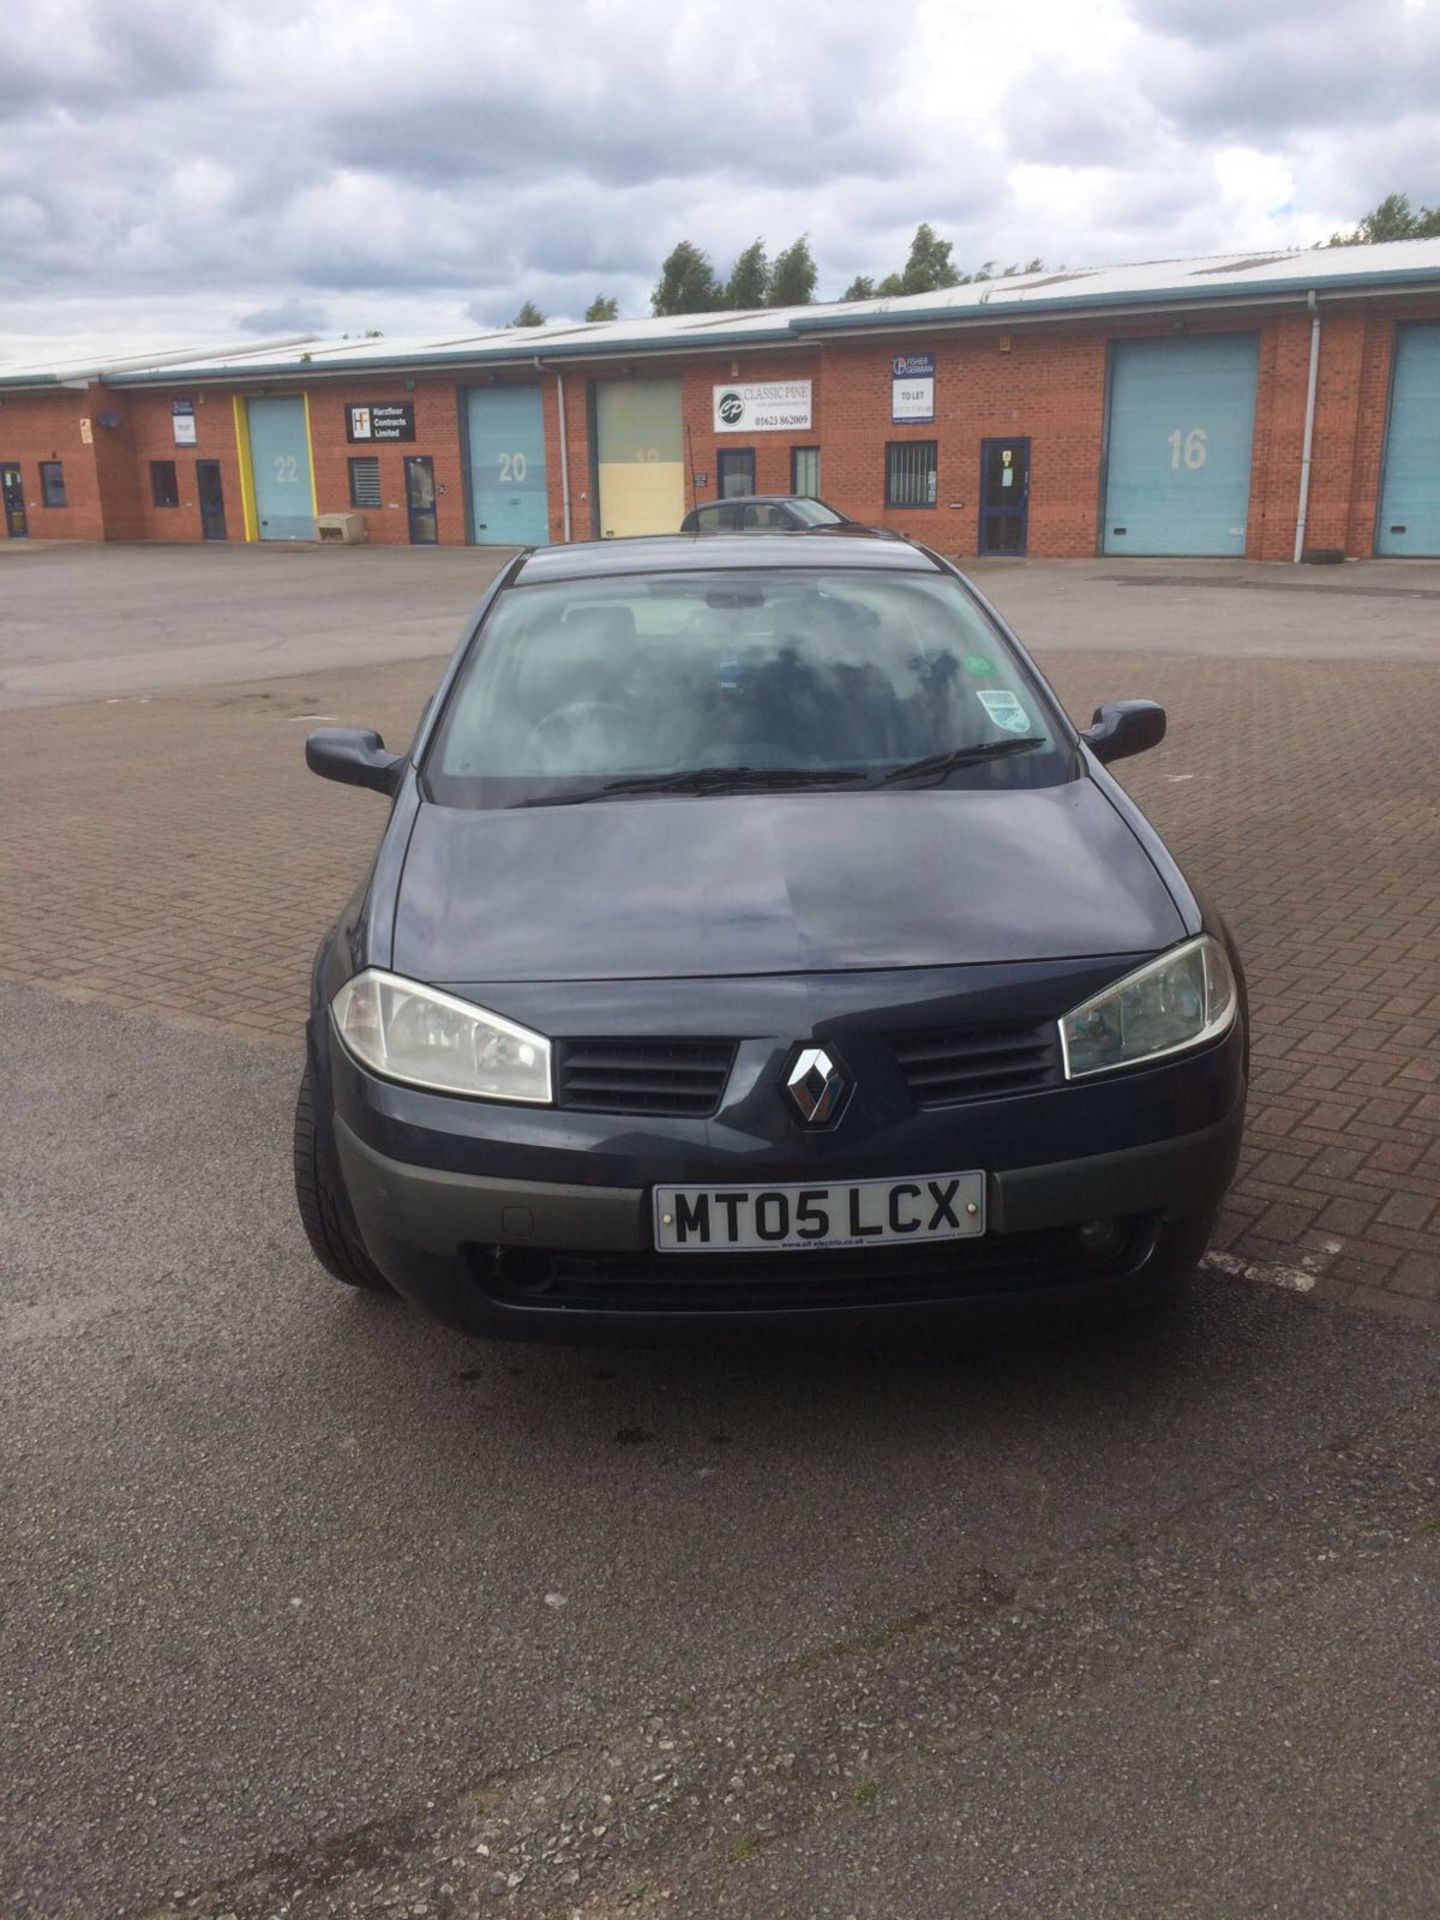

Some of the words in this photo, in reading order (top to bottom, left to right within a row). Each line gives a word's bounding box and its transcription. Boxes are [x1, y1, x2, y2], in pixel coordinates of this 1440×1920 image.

[744, 387, 783, 401] CLASSIC
[785, 386, 808, 399] PINE
[901, 392, 911, 401] TO
[913, 391, 925, 401] LET
[374, 418, 406, 427] Contracts
[755, 416, 778, 426] 01623
[779, 415, 808, 425] 862009
[375, 429, 400, 438] Limited
[1168, 429, 1208, 471] 16
[275, 455, 299, 483] 22
[499, 453, 527, 481] 20
[674, 1191, 829, 1242] MT05
[849, 1179, 961, 1237] LCX
